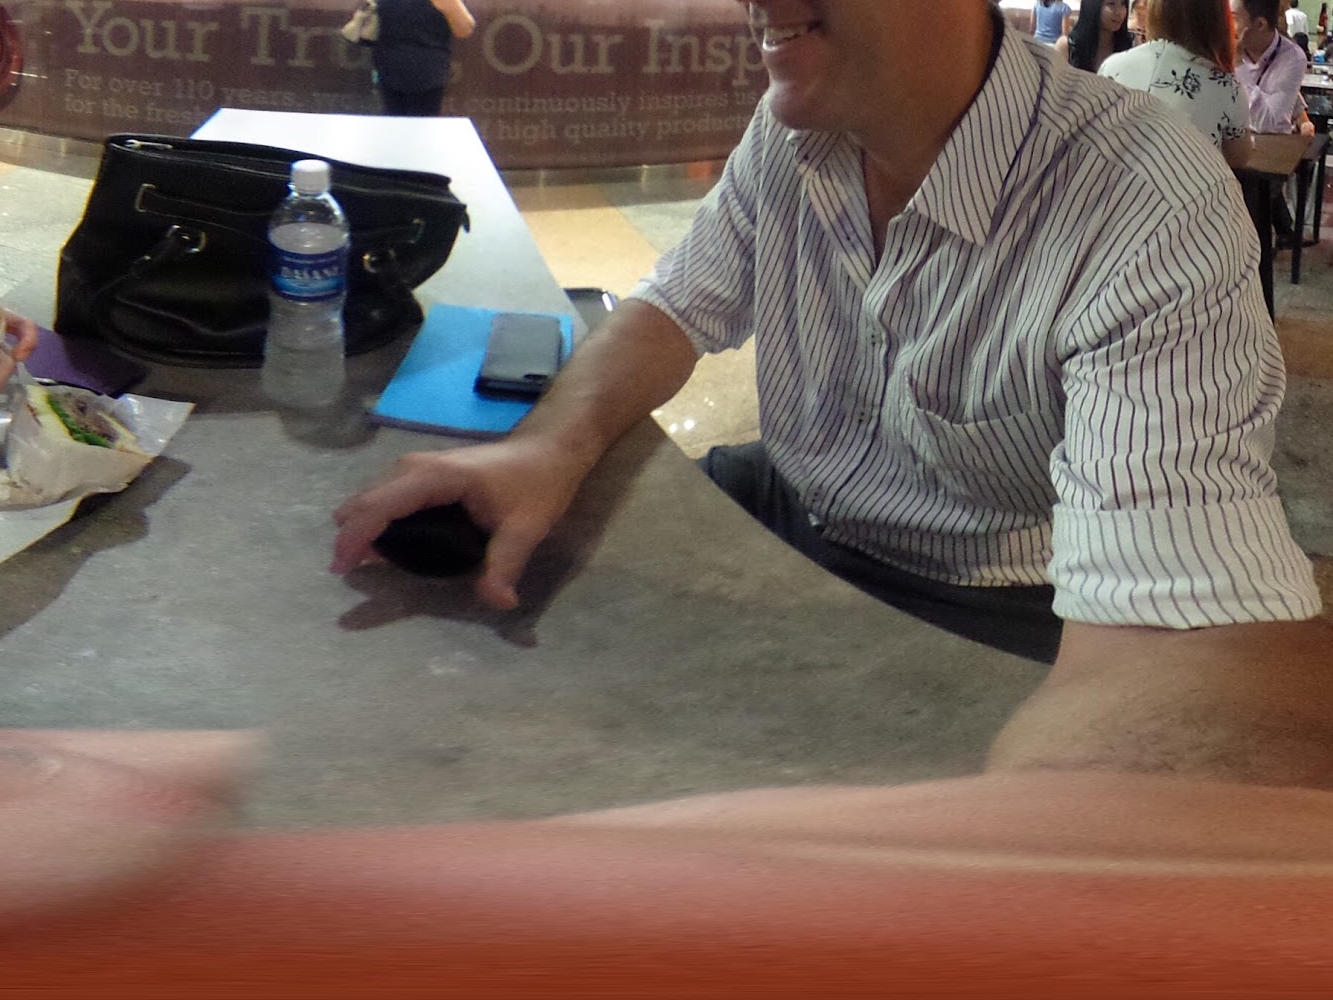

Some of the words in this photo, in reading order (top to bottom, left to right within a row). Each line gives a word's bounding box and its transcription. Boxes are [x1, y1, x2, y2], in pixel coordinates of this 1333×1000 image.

[65, 0, 221, 63] Your
[483, 14, 625, 75] Our
[64, 68, 102, 91] For
[109, 79, 165, 96] over
[175, 78, 215, 100] 110
[639, 91, 731, 113] inspires
[64, 93, 97, 114] for
[102, 98, 139, 119] the
[497, 116, 556, 146] high
[563, 119, 646, 145] quality
